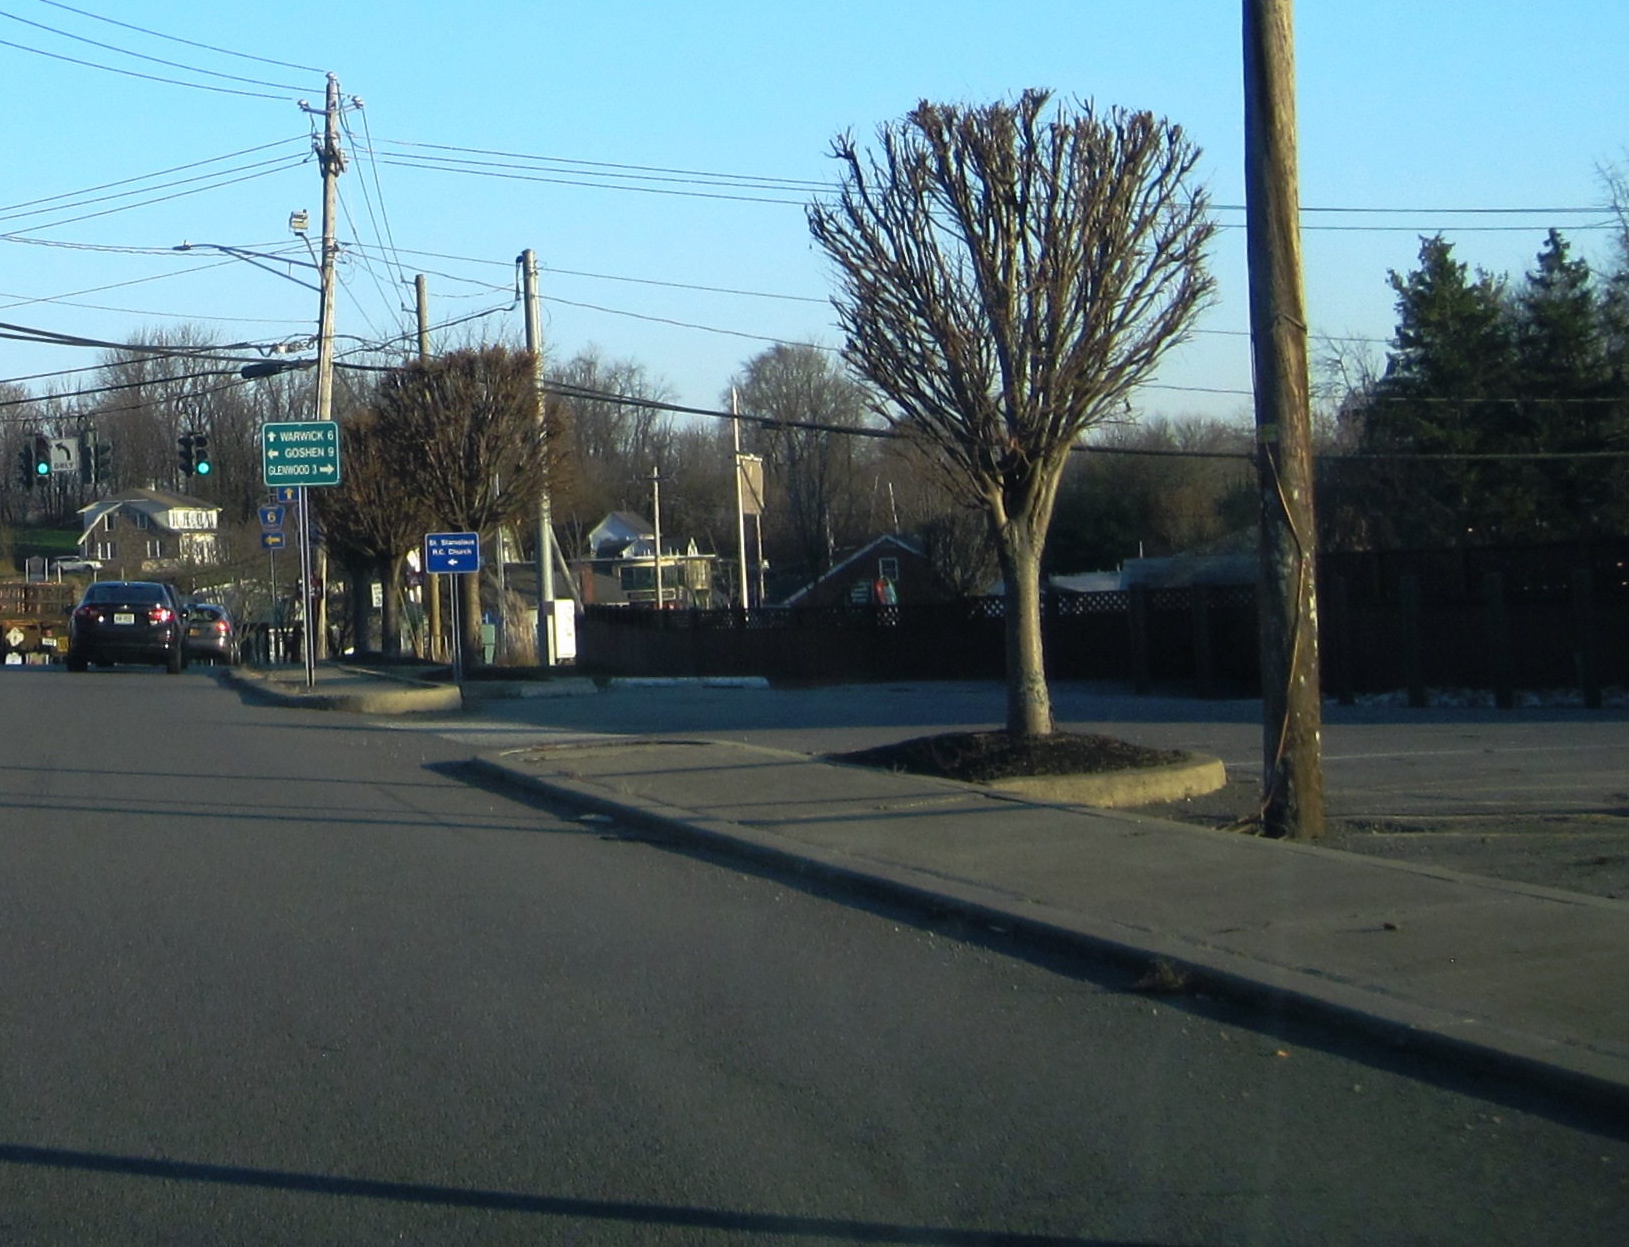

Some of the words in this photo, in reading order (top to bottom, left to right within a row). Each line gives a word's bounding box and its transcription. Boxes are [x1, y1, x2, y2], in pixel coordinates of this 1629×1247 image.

[280, 431, 324, 441] WARWICK
[327, 430, 334, 440] 6
[285, 448, 324, 458] GOSHEN
[328, 447, 335, 457] 9
[268, 465, 310, 475] GLENWOOD
